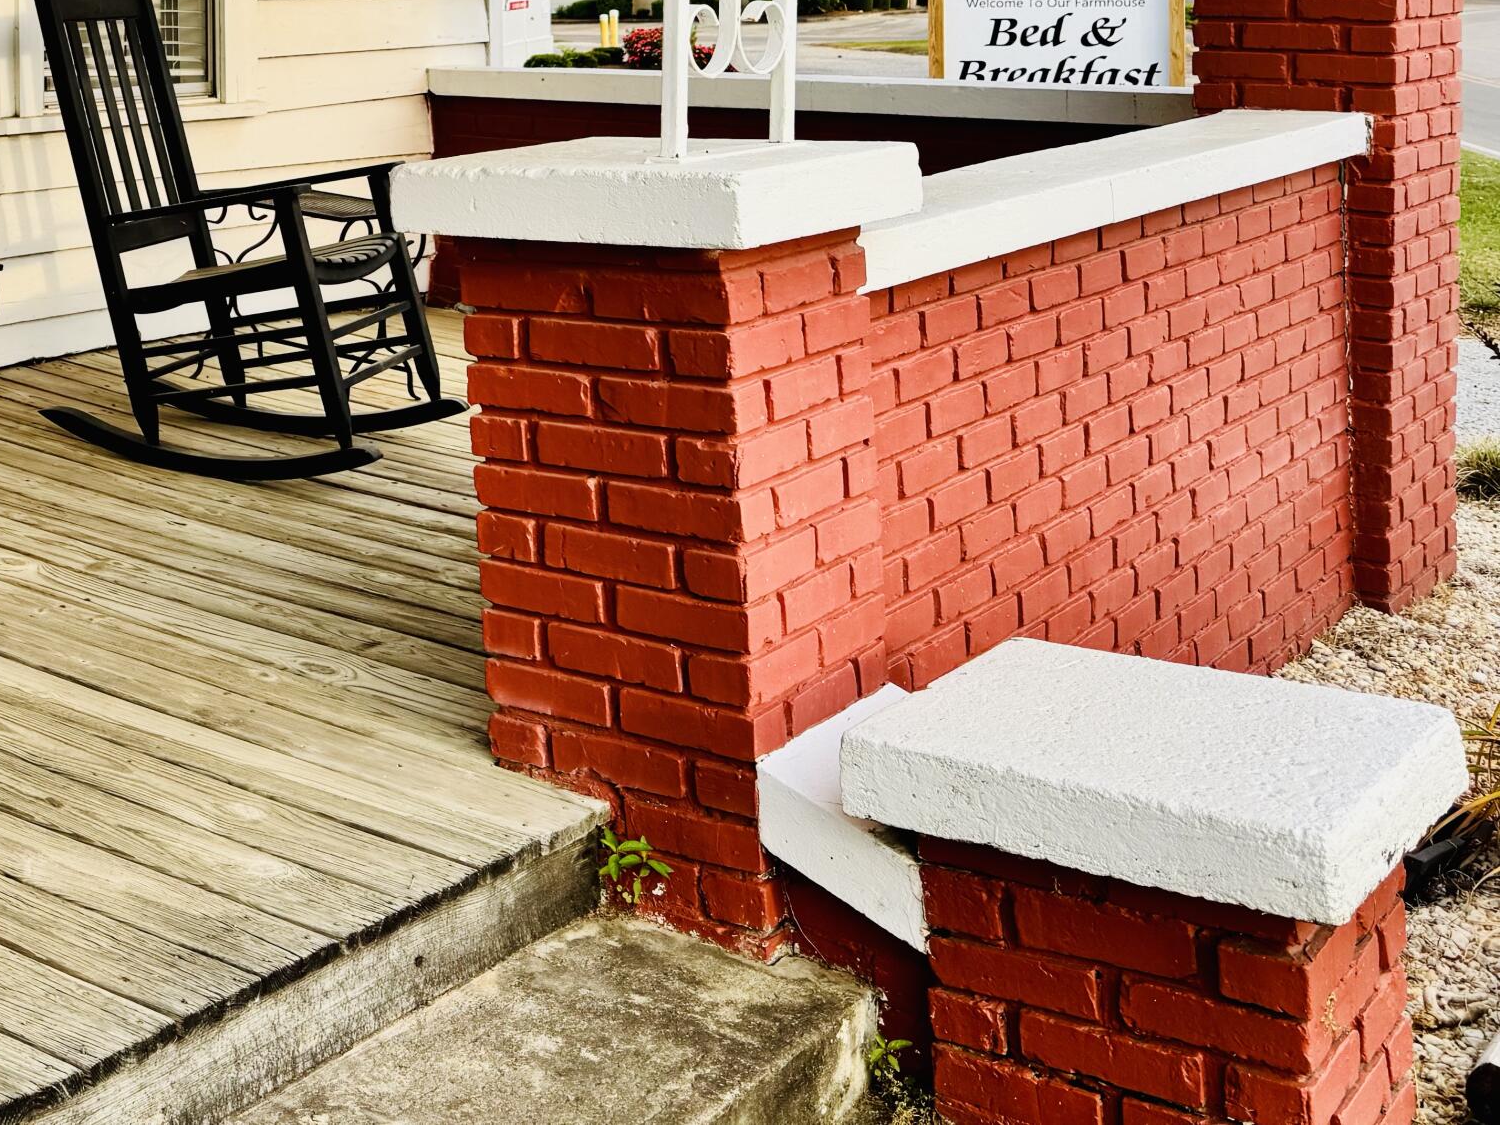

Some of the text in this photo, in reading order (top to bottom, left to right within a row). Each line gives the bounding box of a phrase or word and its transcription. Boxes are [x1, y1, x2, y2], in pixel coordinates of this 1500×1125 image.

[985, 12, 1127, 48] Bed &
[958, 55, 1163, 86] Breakfast
